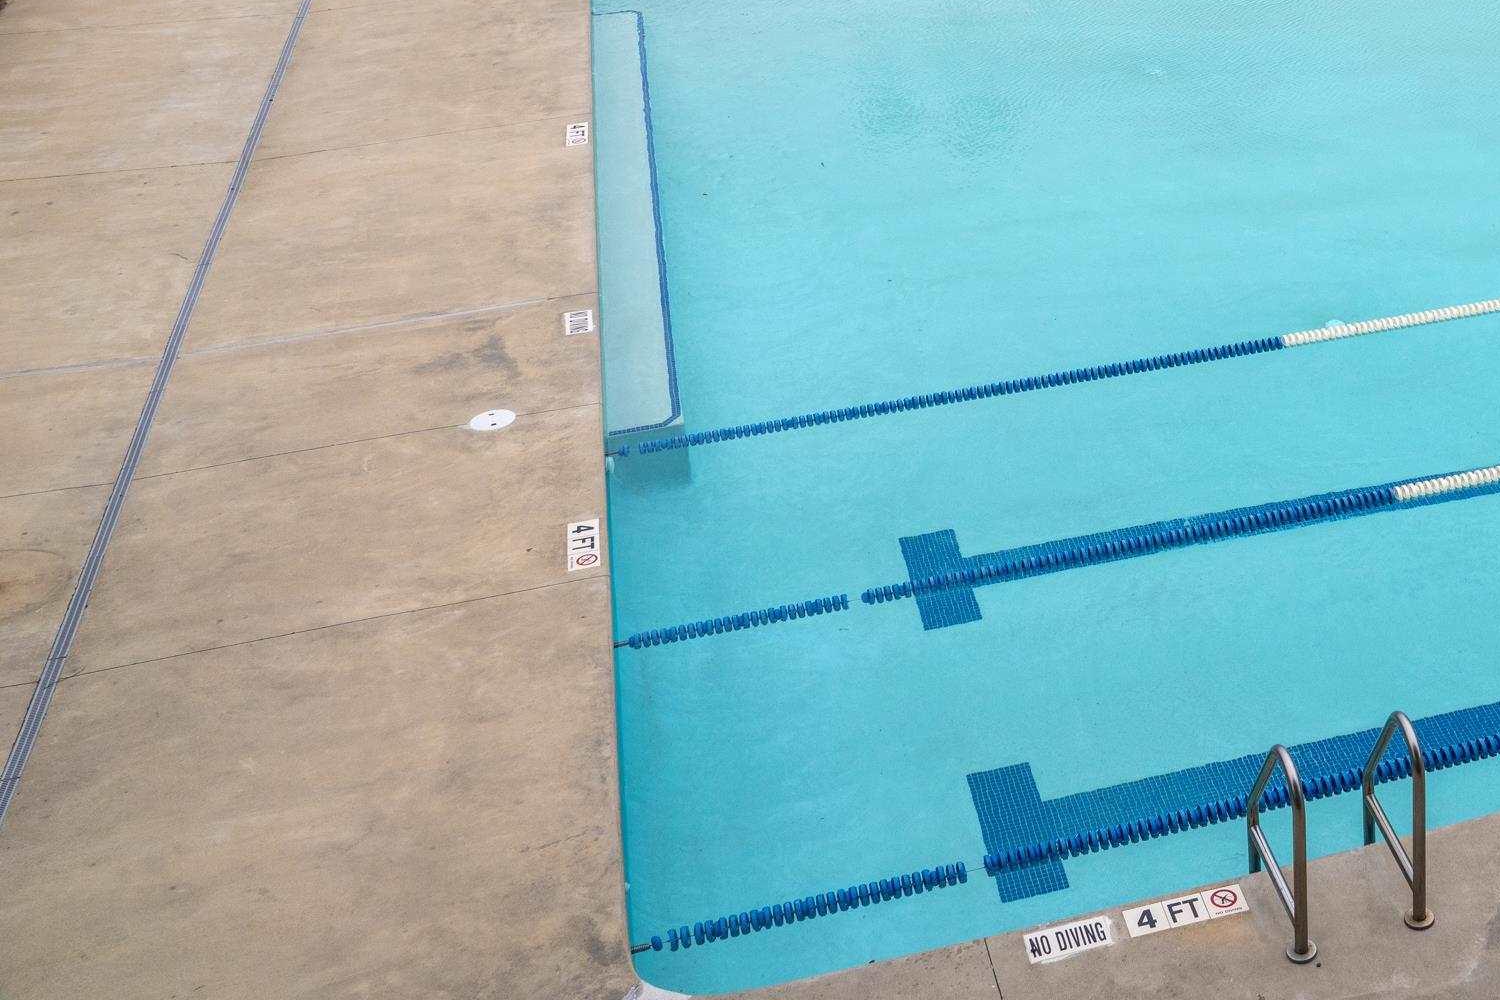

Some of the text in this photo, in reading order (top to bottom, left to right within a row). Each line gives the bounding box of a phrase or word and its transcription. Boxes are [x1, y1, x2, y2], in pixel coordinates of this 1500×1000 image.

[571, 525, 595, 551] 4 FT
[1137, 898, 1200, 929] 4 FT
[1028, 921, 1107, 959] NO DIVING
